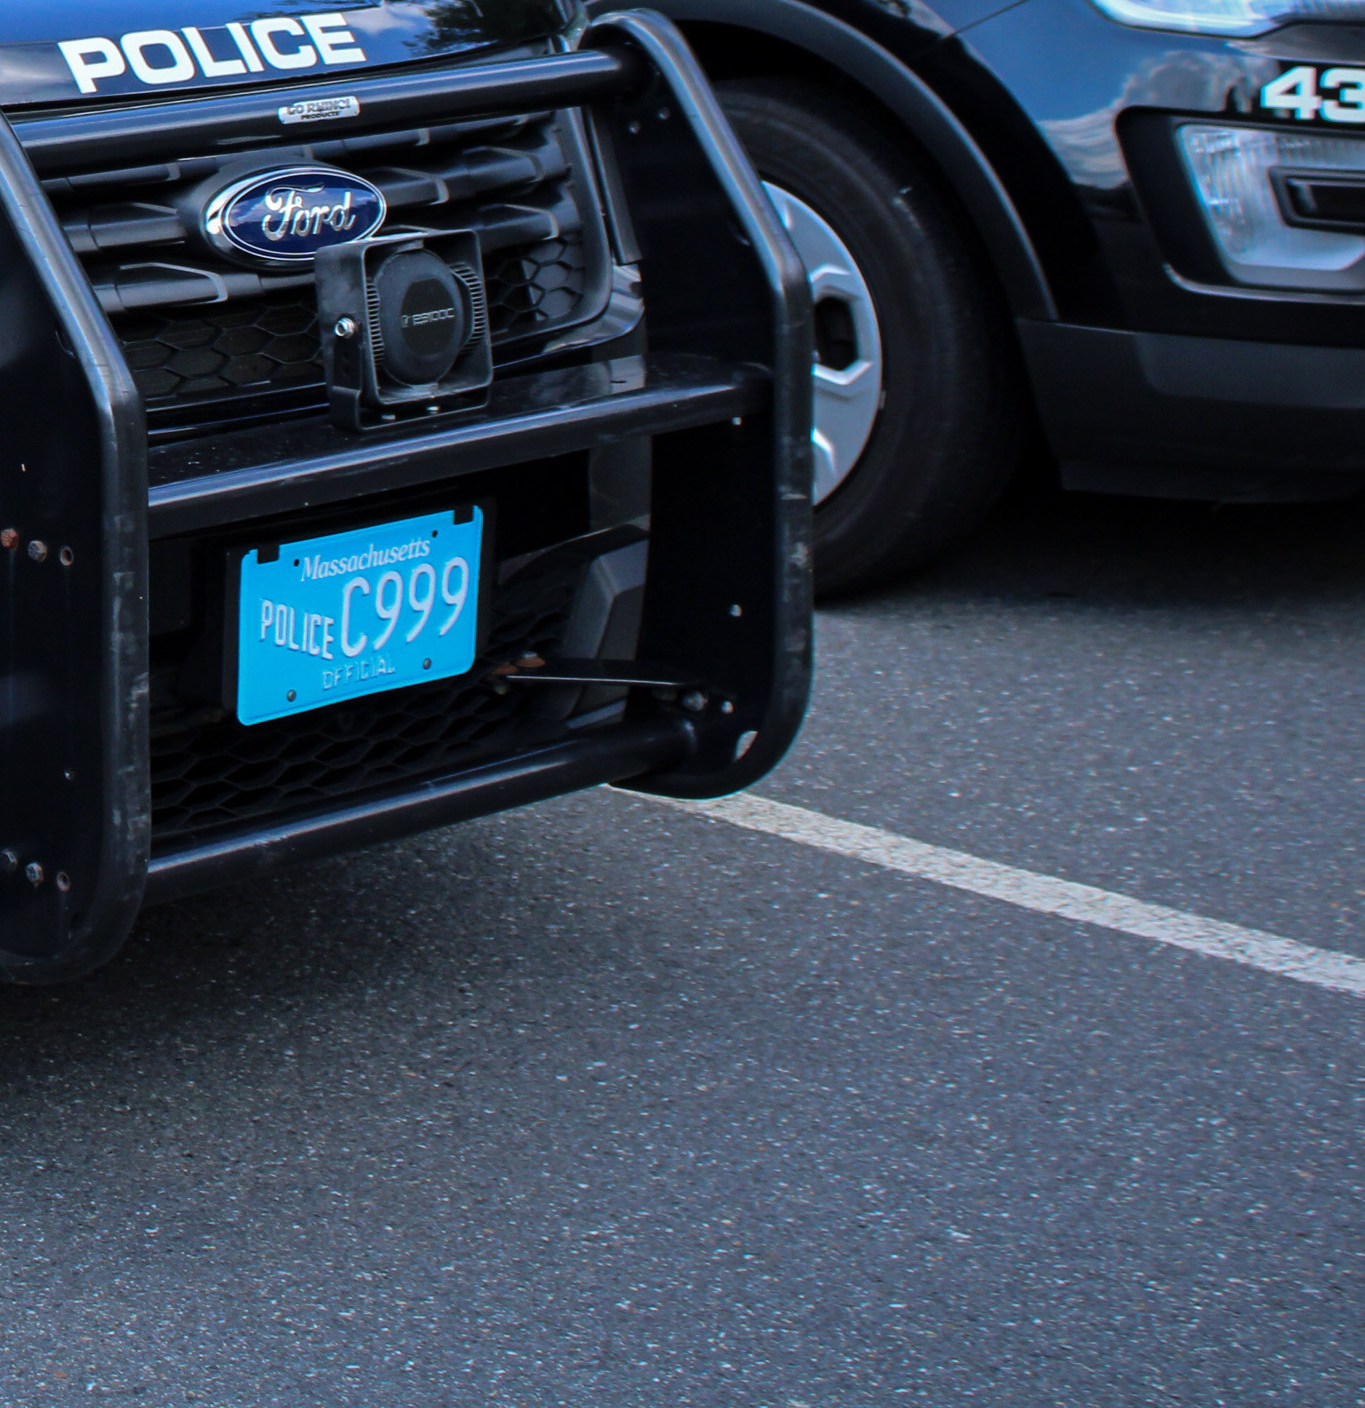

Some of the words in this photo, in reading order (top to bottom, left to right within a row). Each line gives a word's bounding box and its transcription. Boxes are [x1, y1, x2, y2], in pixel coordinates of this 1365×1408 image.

[57, 11, 368, 94] POLICE
[1260, 65, 1365, 123] 43
[261, 182, 357, 242] Ford
[300, 537, 431, 582] Massachusetts
[259, 598, 335, 661] POLICE
[340, 556, 469, 658] C999
[322, 654, 397, 690] OFFICIAL
